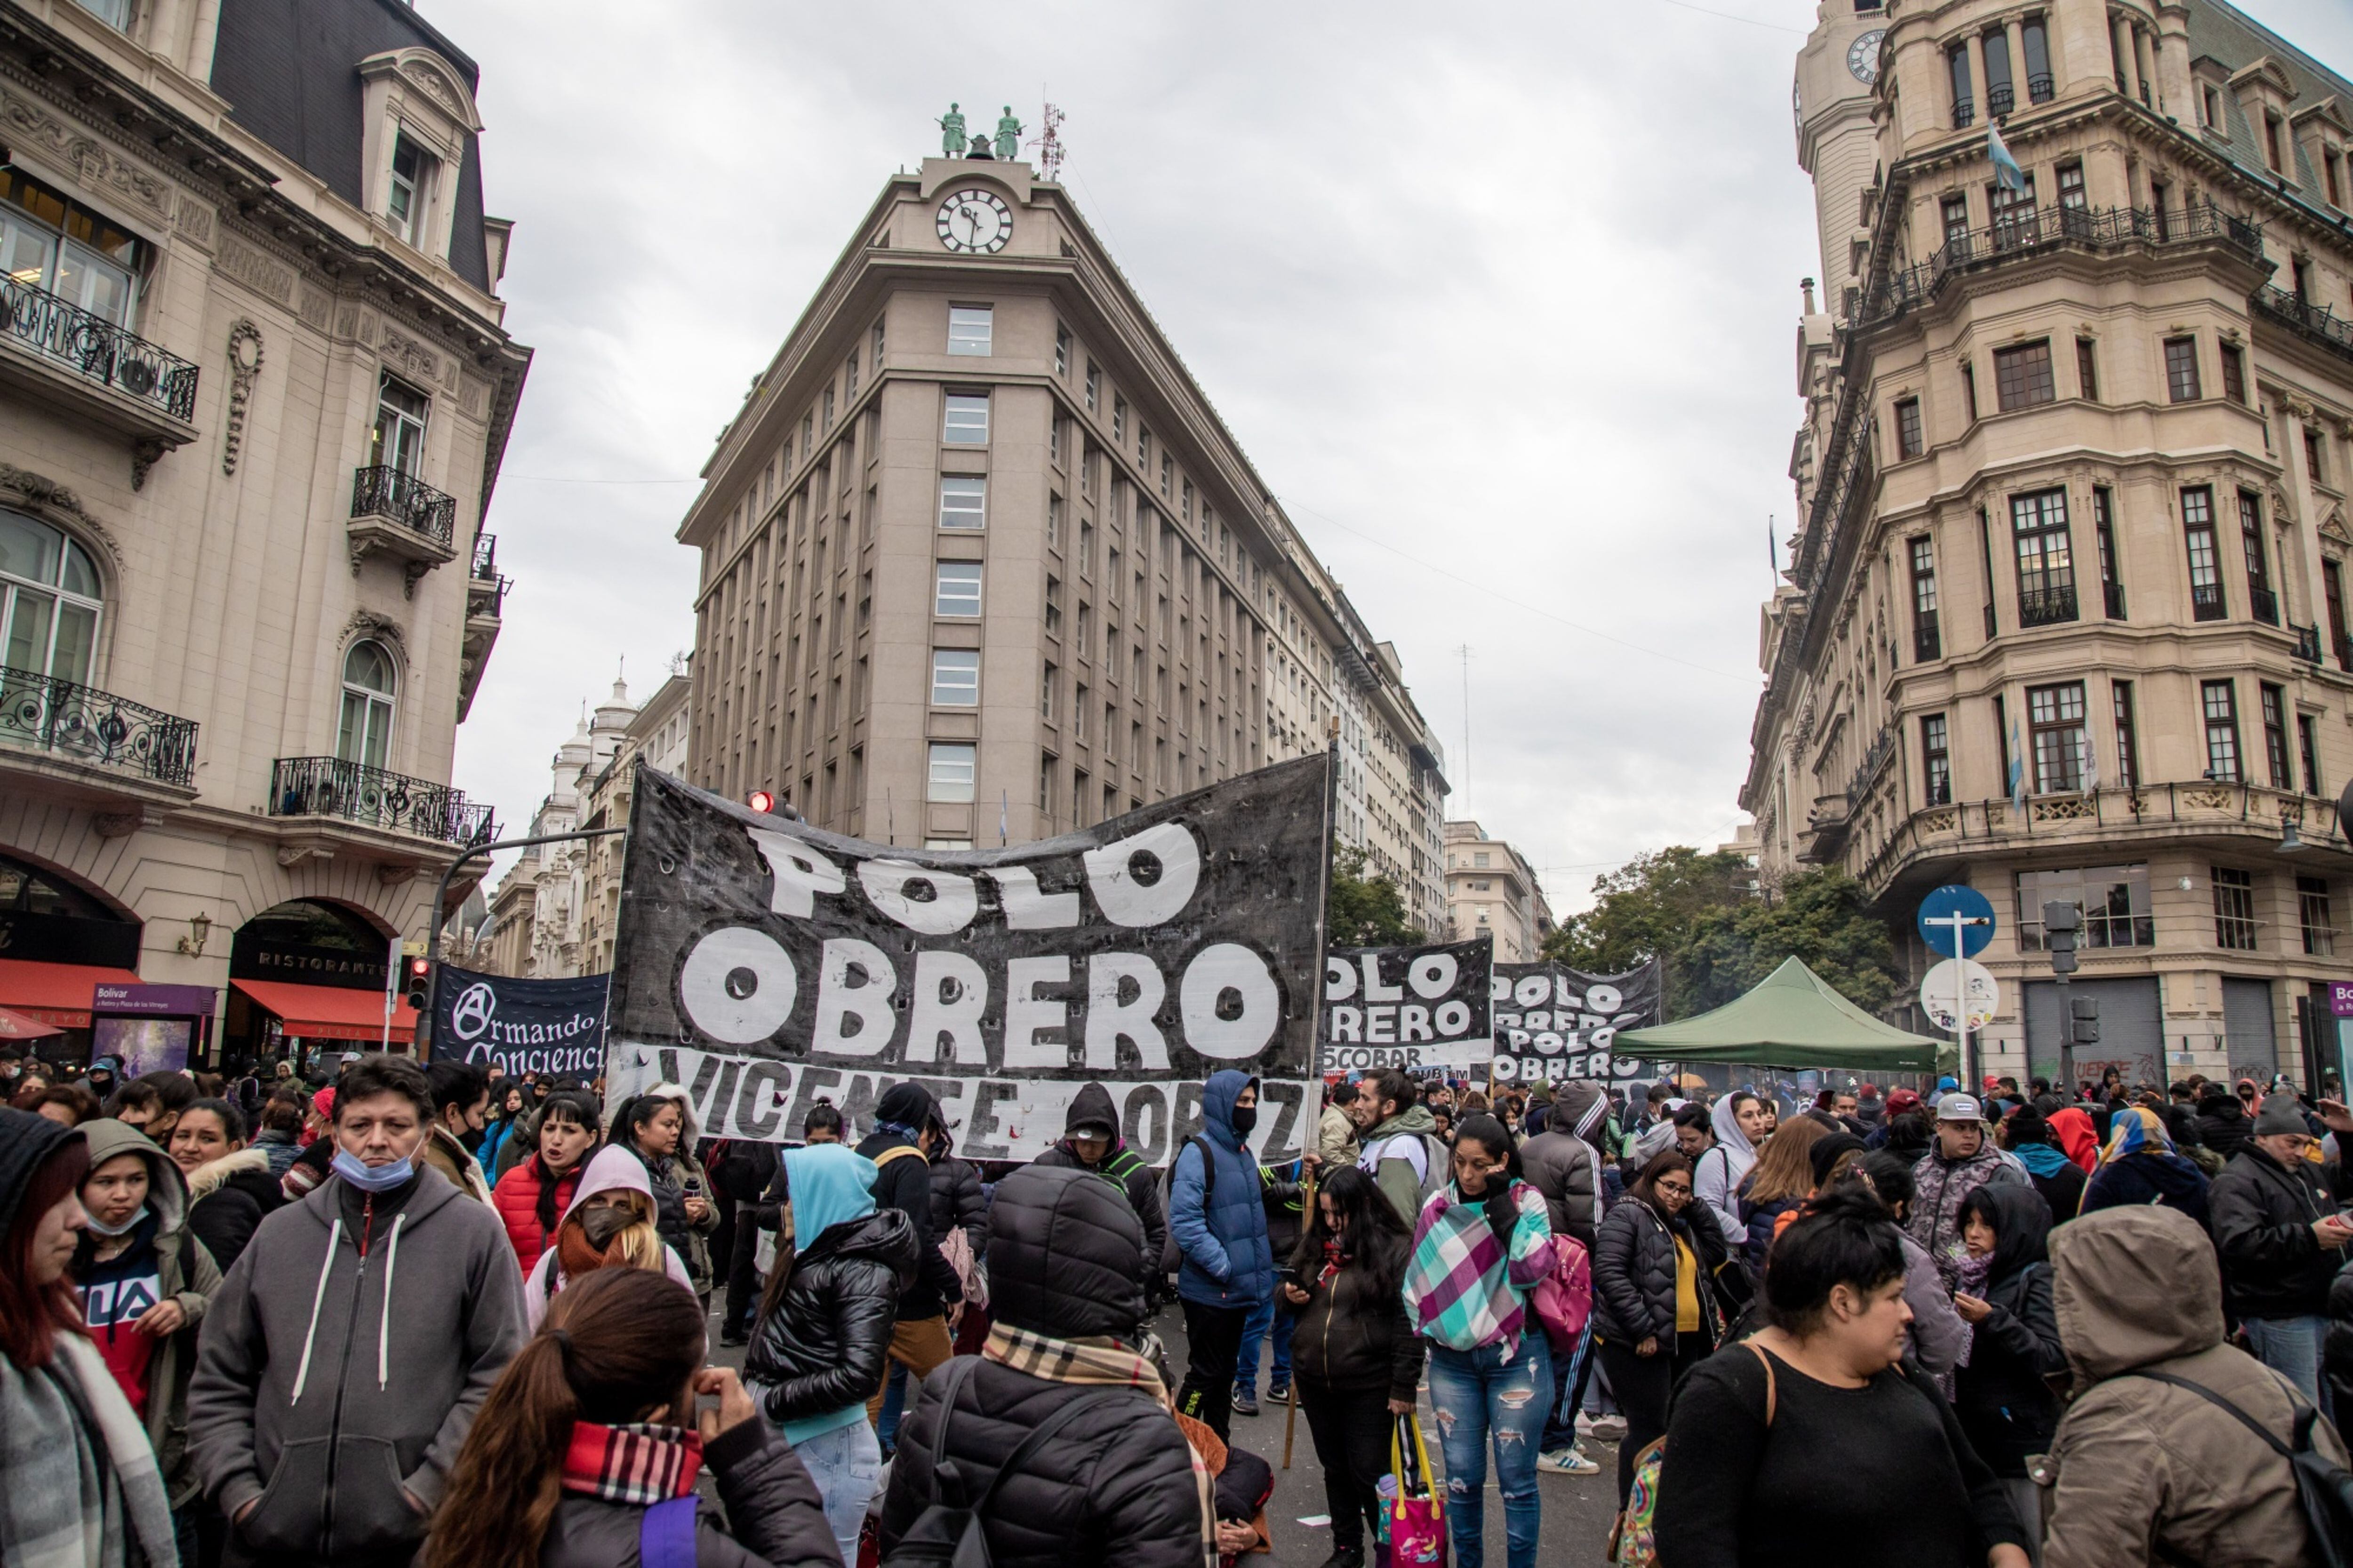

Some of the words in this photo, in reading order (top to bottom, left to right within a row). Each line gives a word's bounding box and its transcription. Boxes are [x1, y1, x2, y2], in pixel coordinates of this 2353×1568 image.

[747, 822, 1201, 934] POLO
[259, 952, 388, 977] RISTORANTE
[1326, 953, 1458, 1001] OLO
[98, 988, 128, 998] Bolívar
[681, 926, 1280, 1070] OBRERO
[1492, 974, 1622, 1012] POLO
[2336, 987, 2353, 1000] Bo
[317, 1028, 362, 1037] PLAZA
[394, 1032, 410, 1040] MA
[1331, 1000, 1470, 1043] RERO
[1509, 1027, 1616, 1055] POLO
[465, 1042, 606, 1076] Concienci
[1324, 1048, 1422, 1069] SCOBAR
[1493, 1052, 1640, 1081] OBRERO
[78, 1281, 156, 1325] LA
